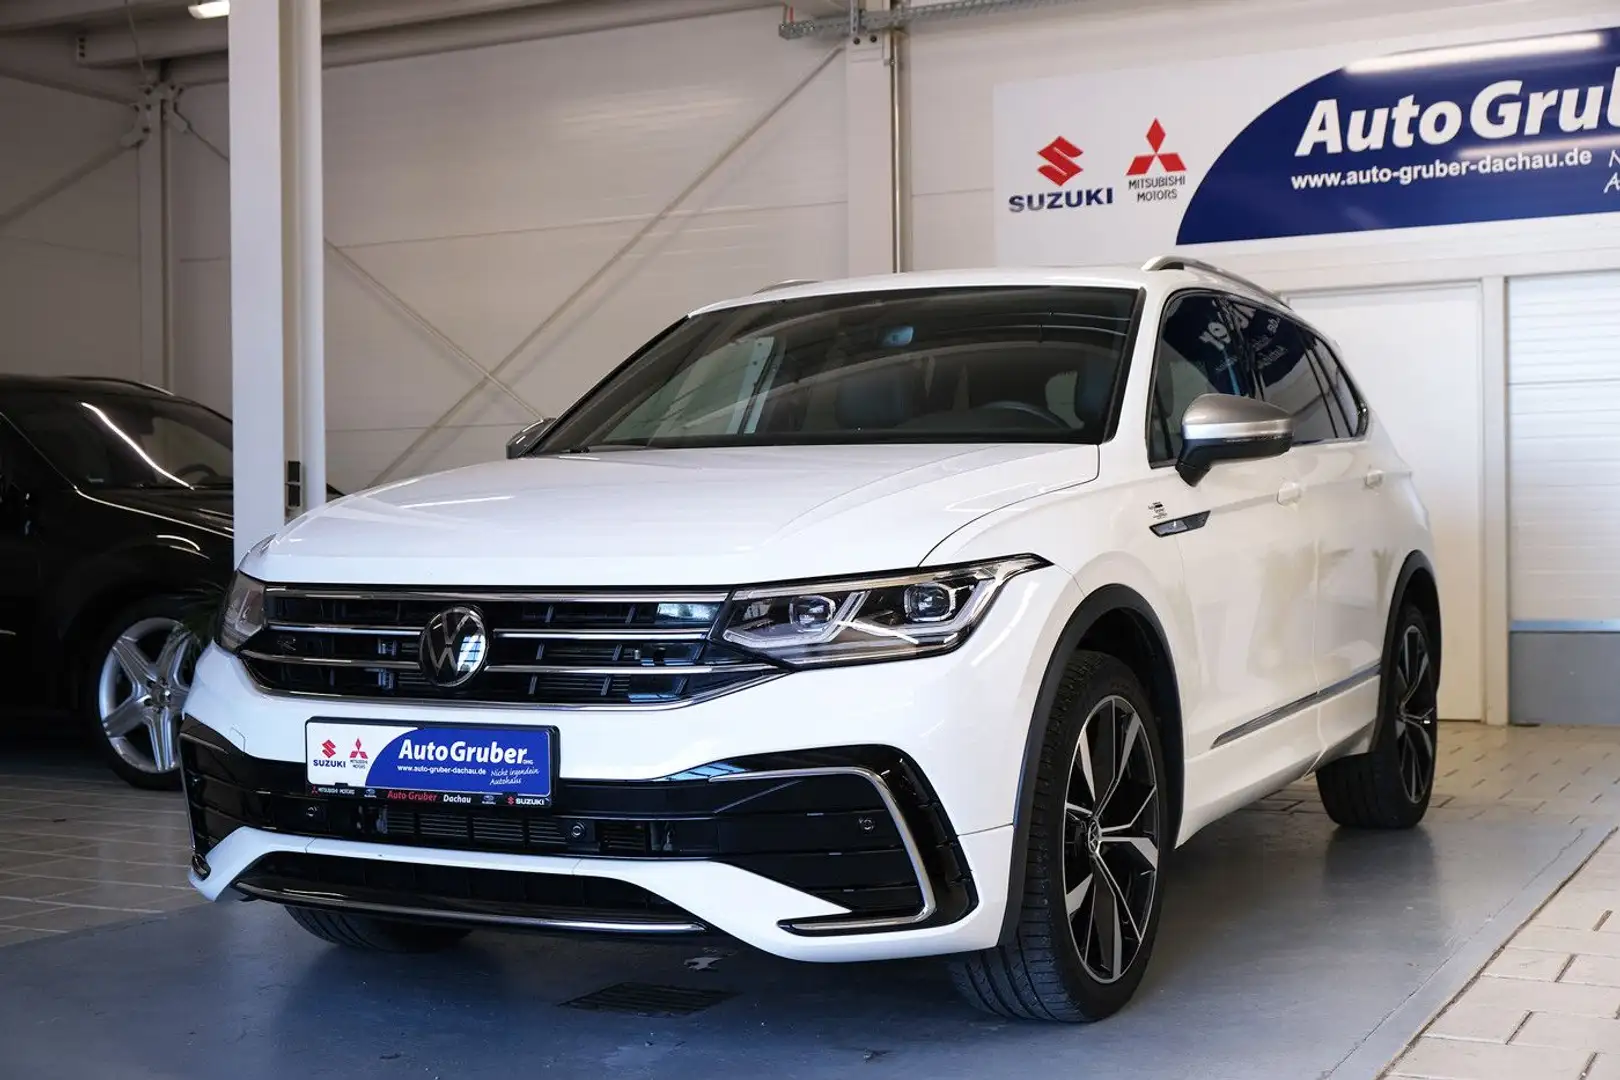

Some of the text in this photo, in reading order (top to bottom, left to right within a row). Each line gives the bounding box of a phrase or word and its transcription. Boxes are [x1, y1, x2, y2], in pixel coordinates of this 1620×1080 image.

[1291, 147, 1593, 190] www.auto-gruber-dachau.de
[1128, 175, 1187, 190] MITSUBISHI
[1008, 187, 1114, 214] SUZUKI
[1136, 188, 1178, 203] MOTORS
[313, 759, 346, 768] SUZUKI
[397, 765, 486, 775] www.auto-gruber-dachau.de
[387, 790, 407, 800] Auto
[408, 791, 438, 801] Gruber
[443, 794, 471, 804] Dachau
[515, 797, 545, 806] SUZUKI
